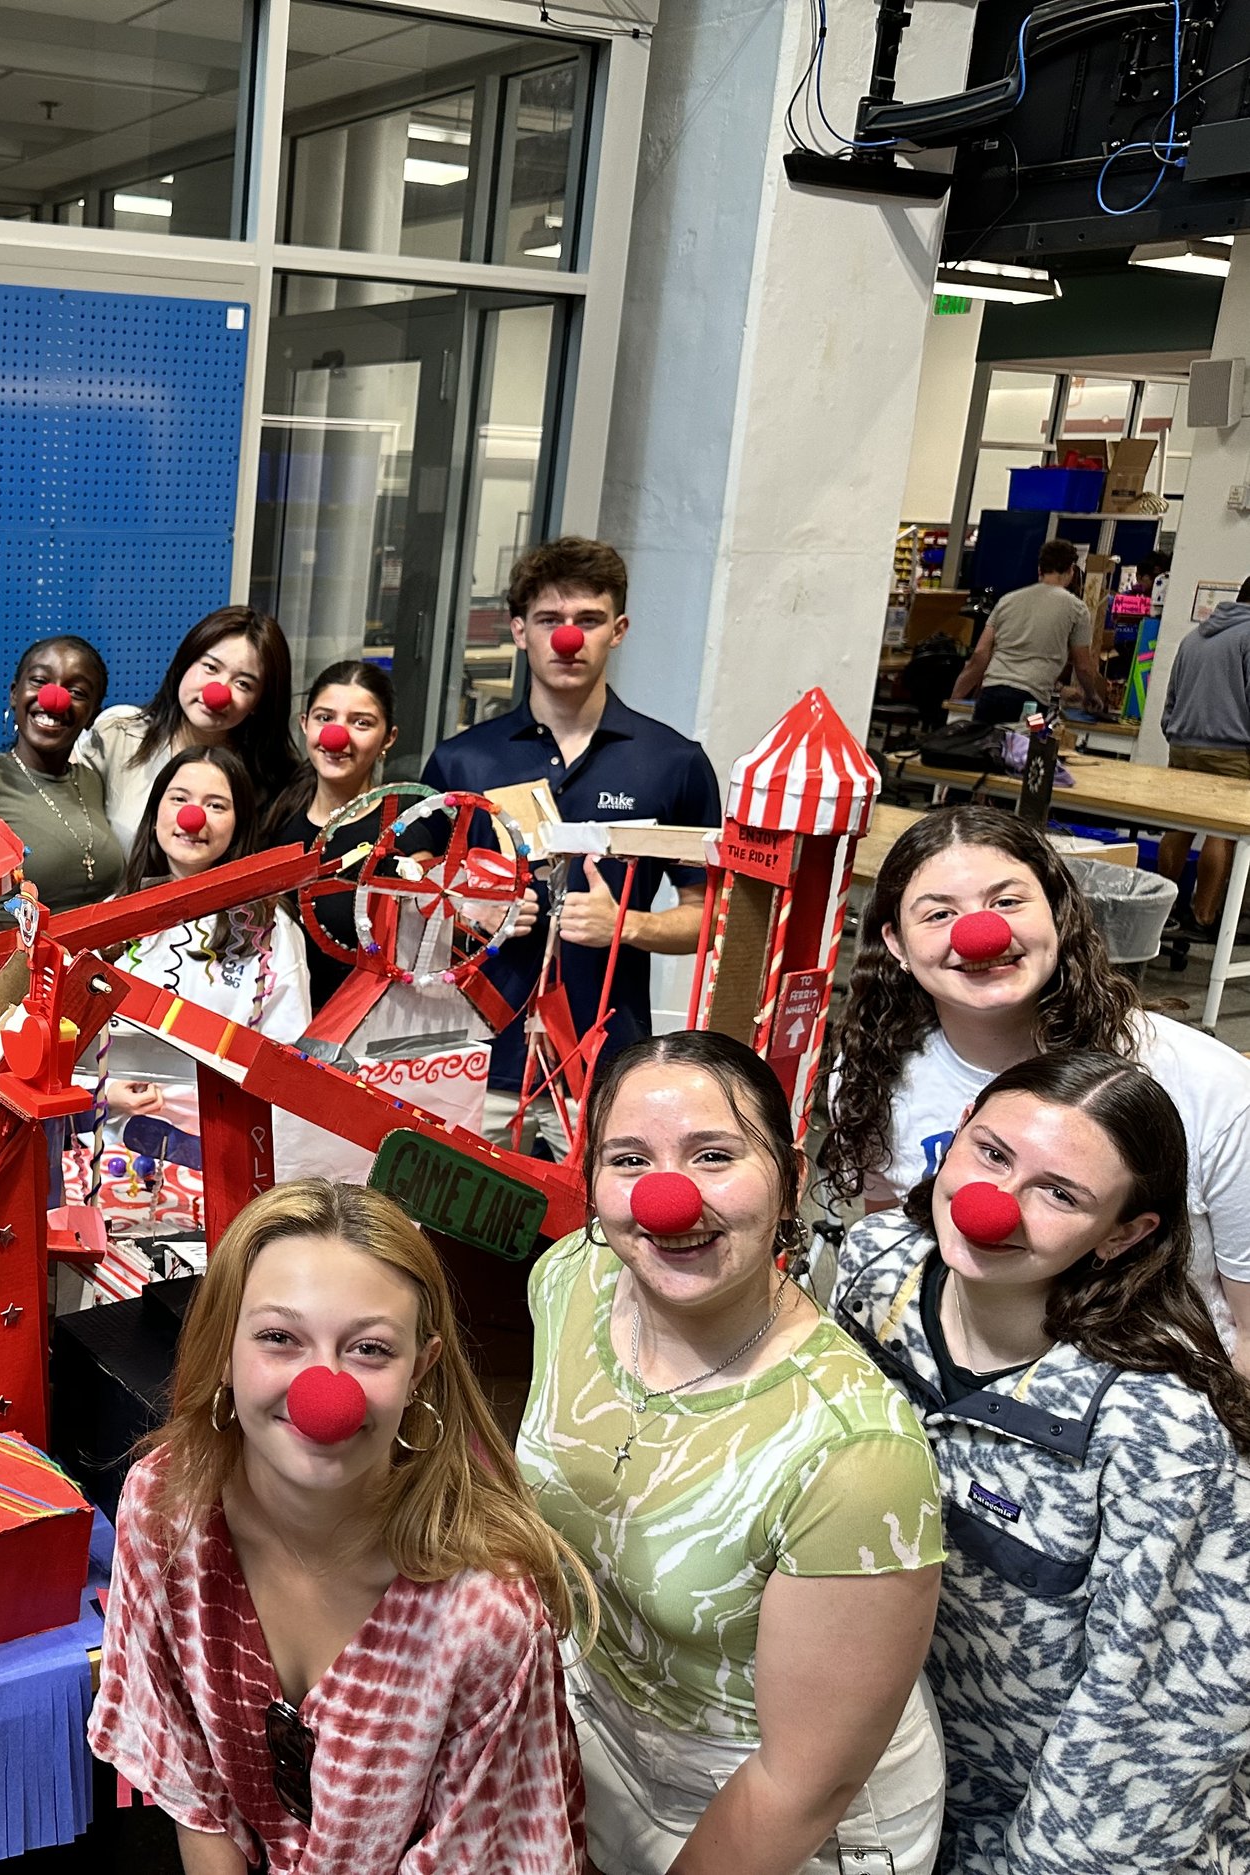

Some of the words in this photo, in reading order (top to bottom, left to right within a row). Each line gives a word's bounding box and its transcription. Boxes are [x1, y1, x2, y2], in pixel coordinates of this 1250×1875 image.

[598, 791, 637, 807] Duke
[738, 826, 779, 851] ENJOY
[727, 844, 747, 860] THE
[748, 848, 779, 870] RIDE!
[800, 975, 813, 987] TO
[386, 1140, 473, 1227] GAME
[461, 1176, 538, 1255] LANE
[972, 1491, 1015, 1519] patagonia
